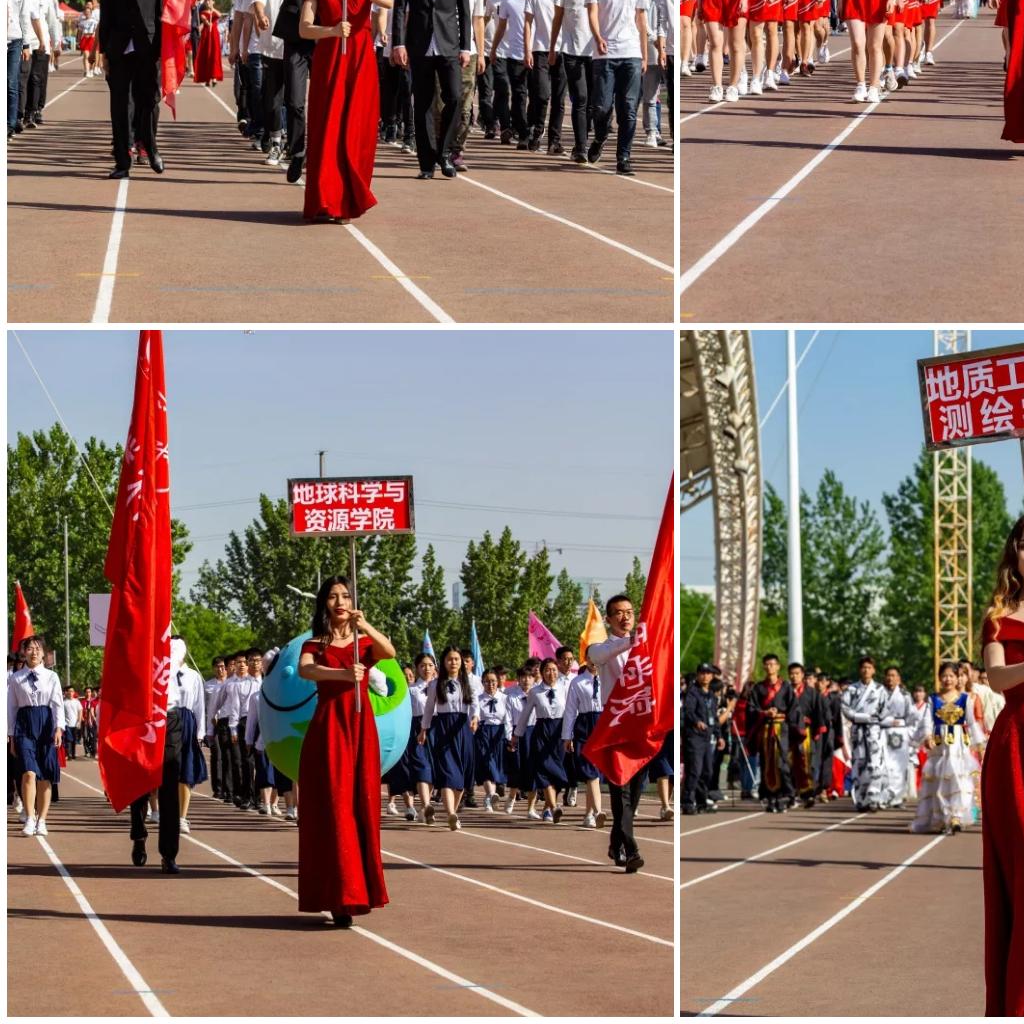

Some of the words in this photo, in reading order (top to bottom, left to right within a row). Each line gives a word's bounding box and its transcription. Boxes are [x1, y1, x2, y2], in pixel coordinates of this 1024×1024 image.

[292, 481, 406, 505] 地球科学与
[304, 507, 395, 532] 资源学院
